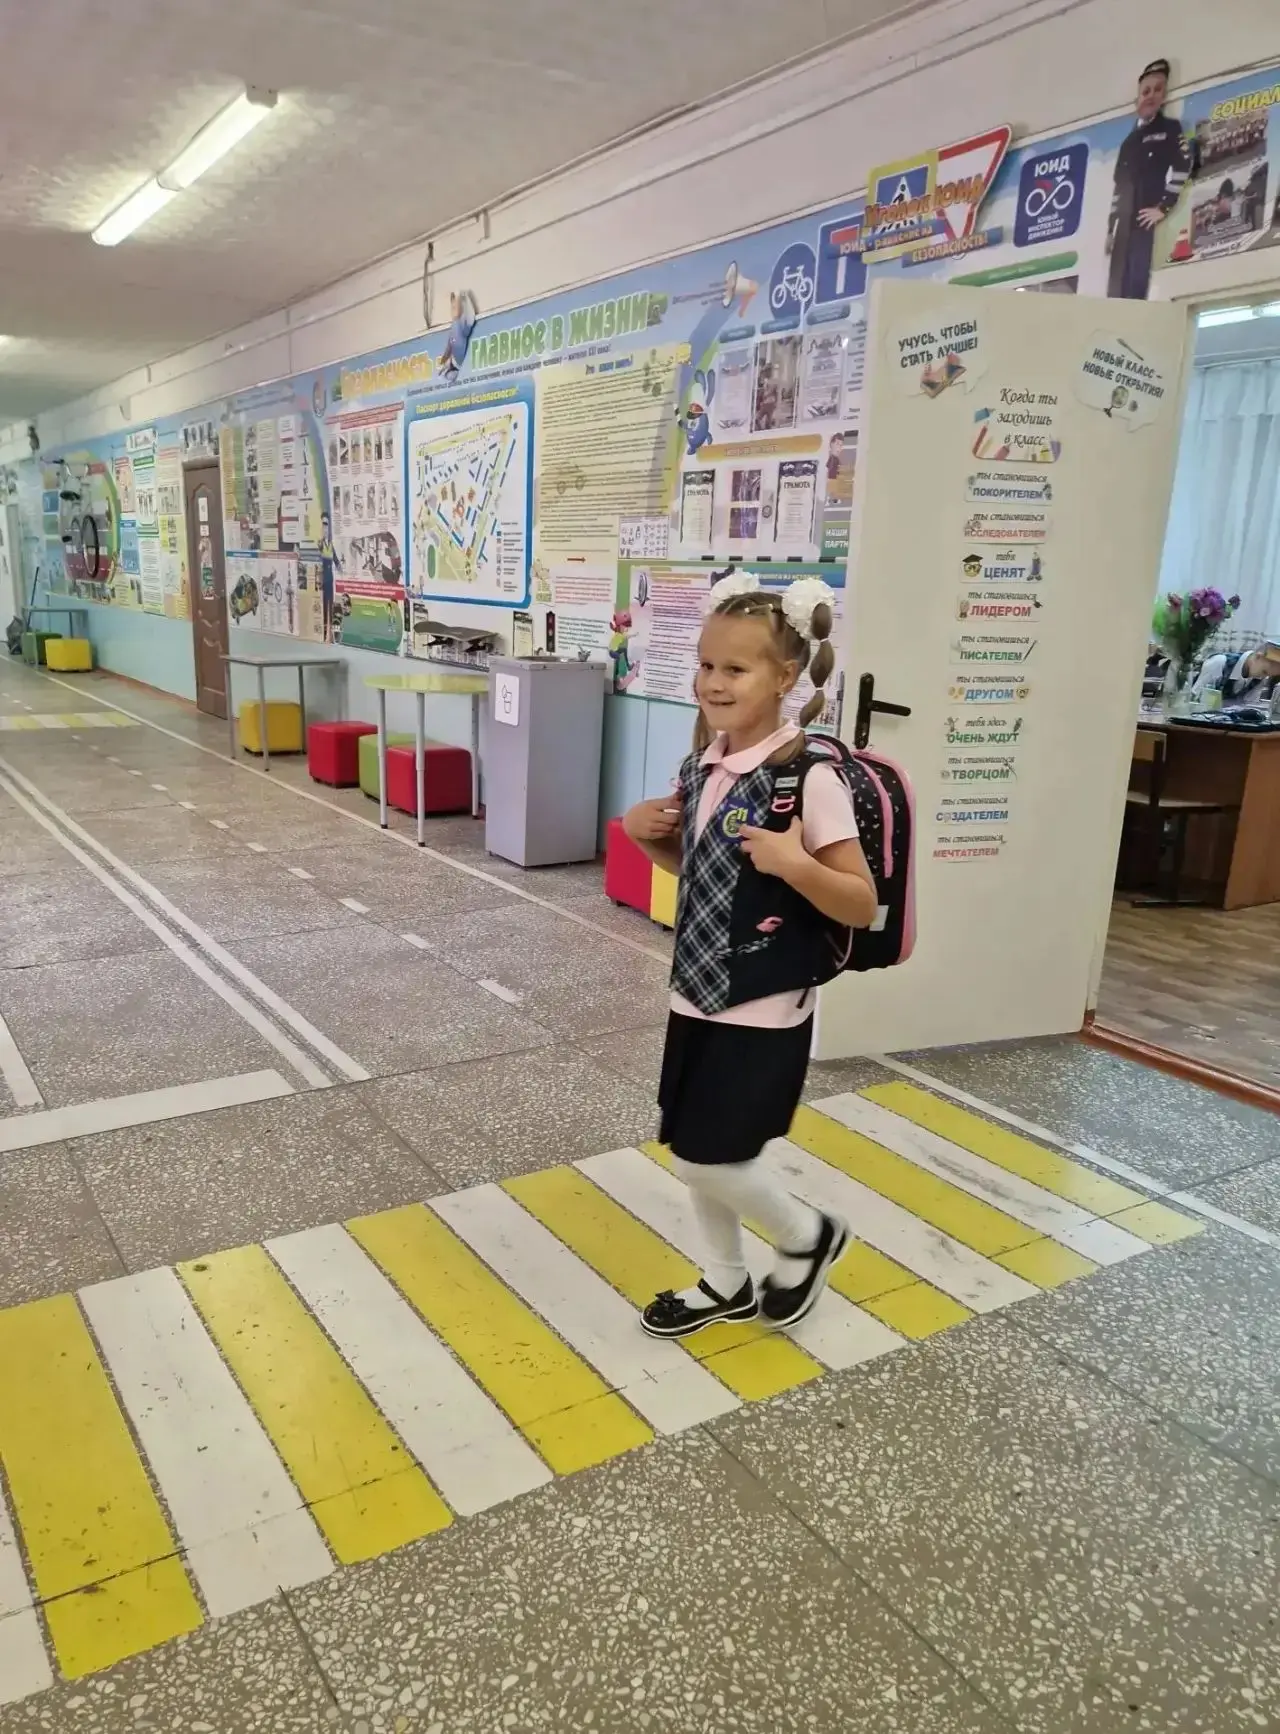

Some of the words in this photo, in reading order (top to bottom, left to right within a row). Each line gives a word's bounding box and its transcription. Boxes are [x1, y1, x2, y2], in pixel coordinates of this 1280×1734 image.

[1035, 155, 1070, 178] ЮИД
[1028, 219, 1065, 232] ИНСПЕКТОР
[1028, 226, 1063, 240] ДВИЖЕНИЯ
[940, 320, 977, 340] ЧТОБЫ
[900, 350, 933, 368] СТАТЬ
[937, 337, 978, 359] ЛУЧШЕ!
[1092, 348, 1125, 368] НОВЫЙ
[1124, 360, 1155, 380] КЛАСС
[1082, 361, 1114, 381] НОВЫЕ
[1115, 372, 1164, 399] ОТКРЫТИЯ!
[1000, 387, 1035, 405] Когда
[1038, 395, 1058, 405] ты
[997, 411, 1052, 426] заходишь
[1004, 433, 1010, 443] в
[1013, 434, 1046, 446] класс
[976, 472, 991, 480] ты
[784, 481, 810, 489] ГРАМОТА
[973, 487, 1043, 499] ПОКОРИТЕЛЕМ
[964, 529, 1046, 538] ИССЛЕДОВАТЕЛЕМ
[984, 568, 1026, 580] ЦЕНЯТ
[970, 605, 1031, 618] ЛИДЕРОМ
[960, 651, 1022, 660] ПИСАТЕЛЕМ
[965, 689, 1014, 700] ДРУГОМ
[947, 733, 984, 743] ОЧЕНЬ
[988, 733, 1019, 743] ЖДУТ
[952, 769, 1009, 780] ТВОРЦОМ
[933, 847, 999, 858] МЕЧТАТЕЛЕМ
